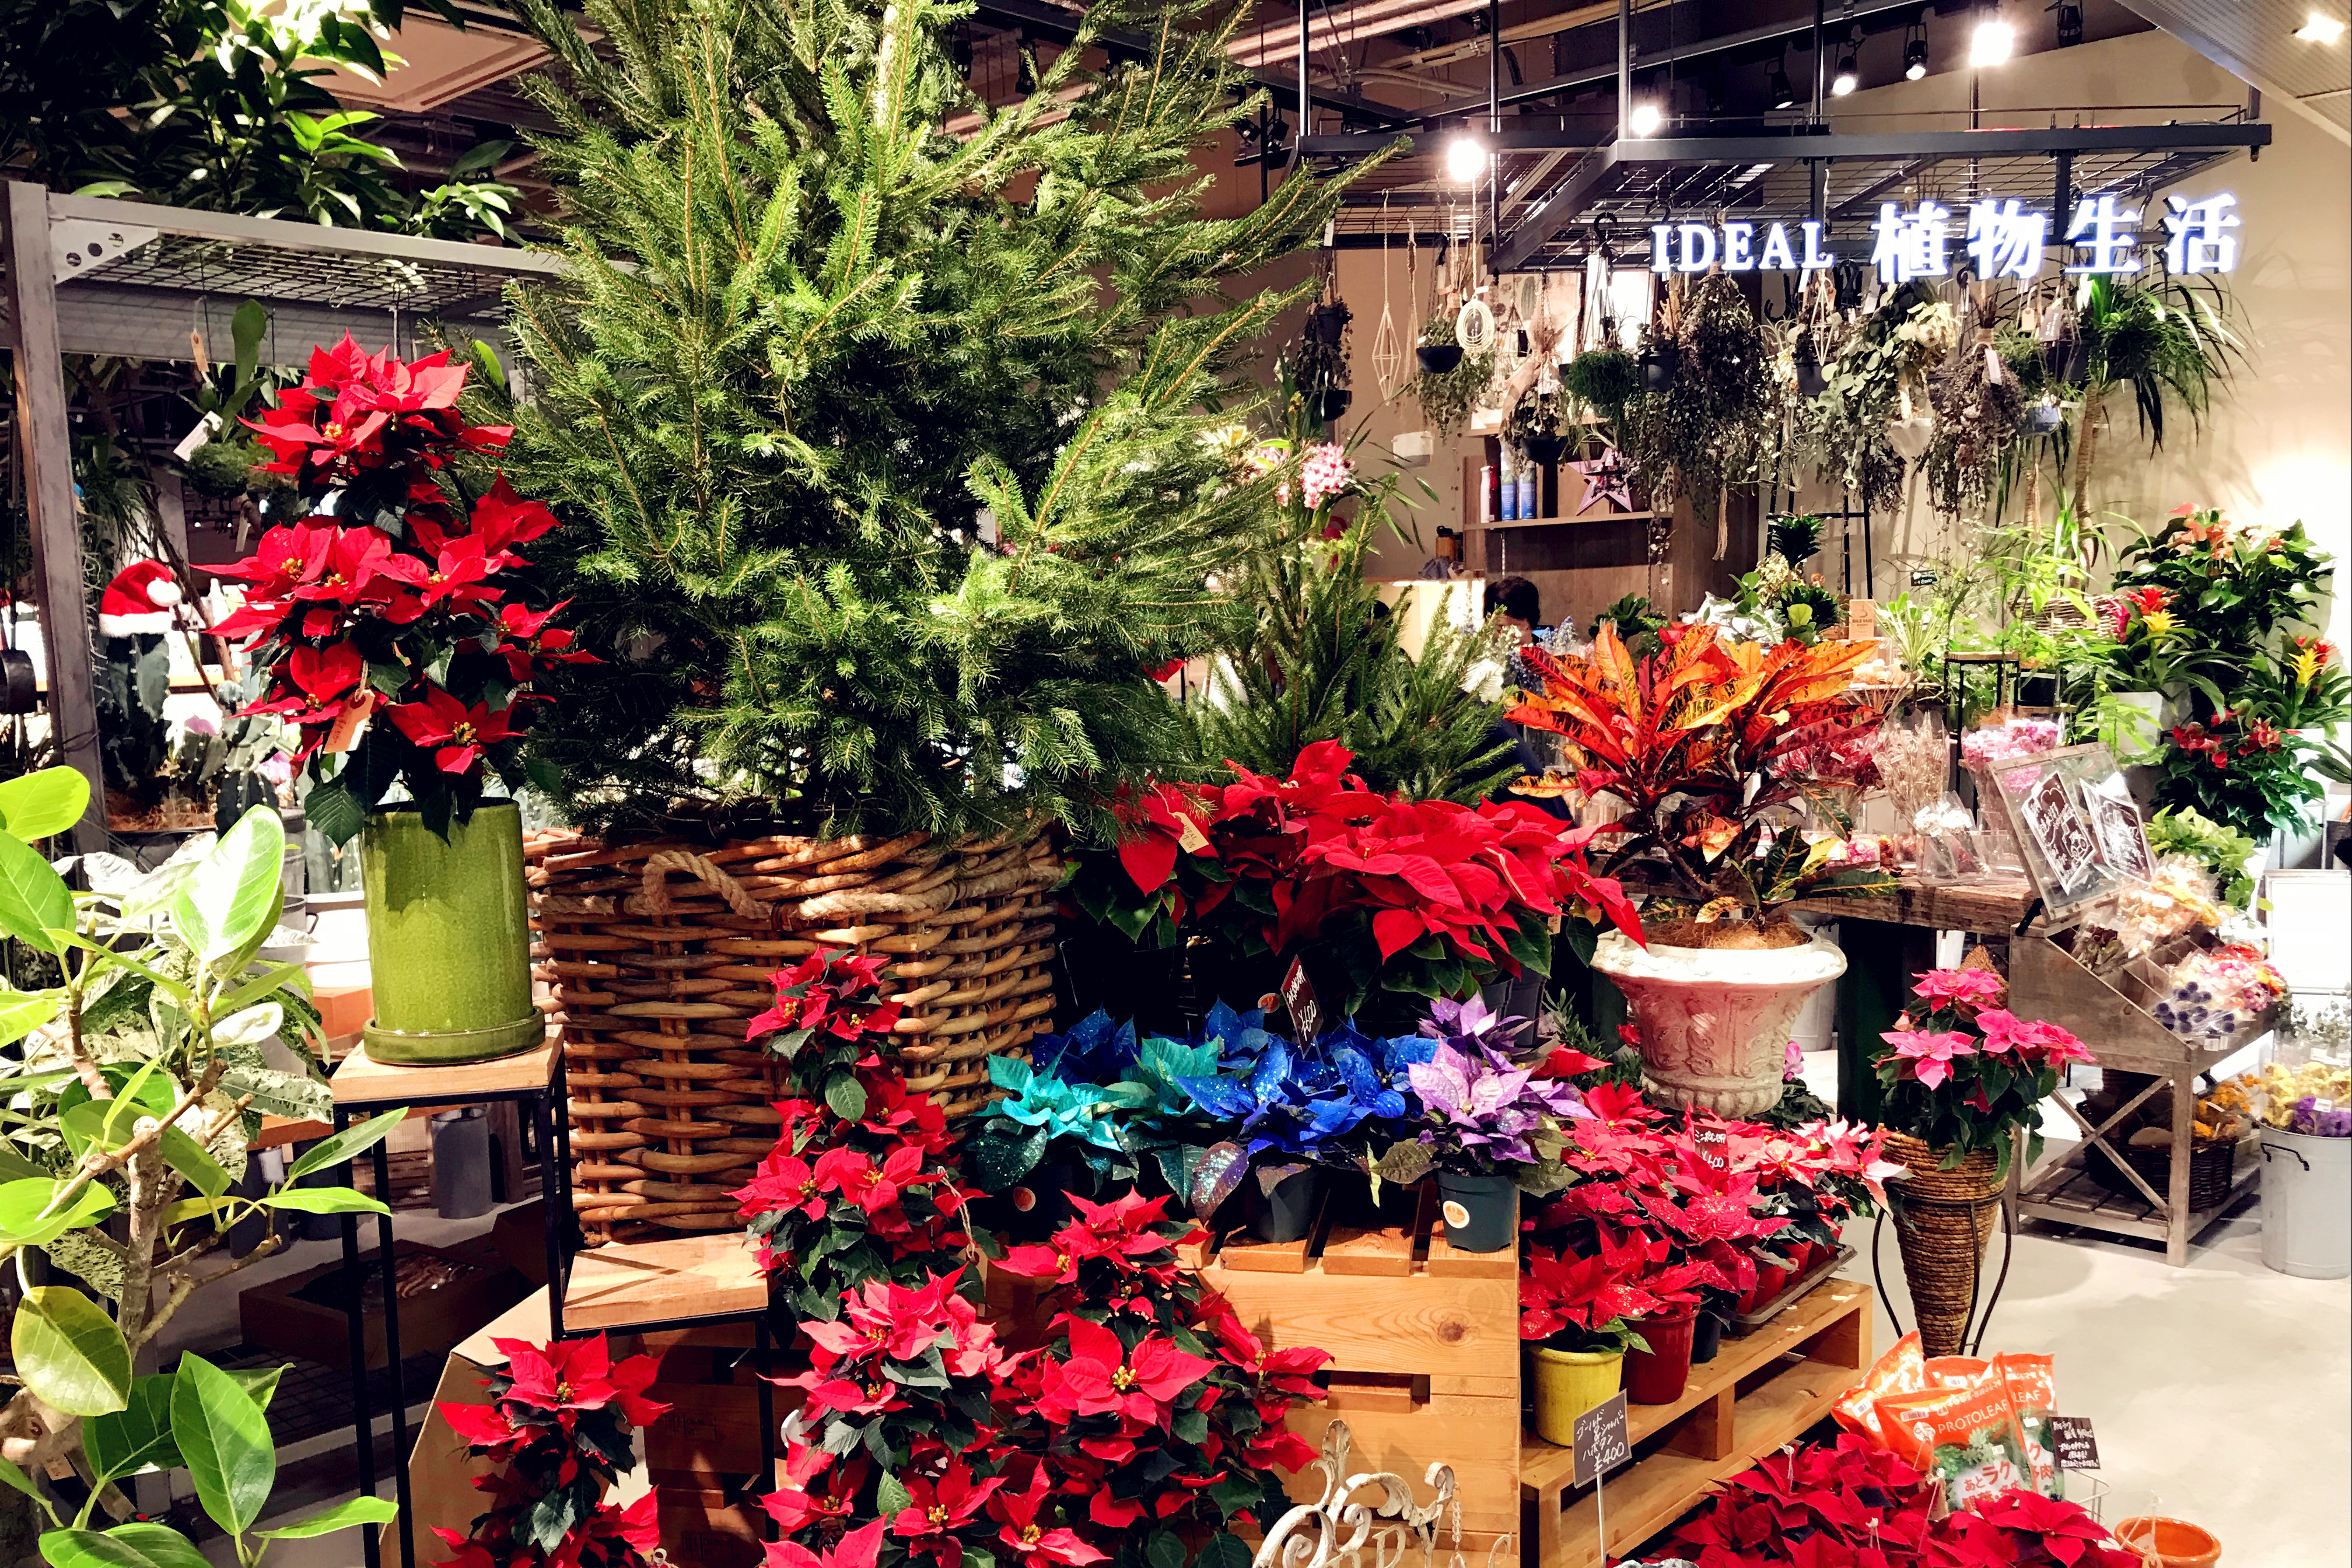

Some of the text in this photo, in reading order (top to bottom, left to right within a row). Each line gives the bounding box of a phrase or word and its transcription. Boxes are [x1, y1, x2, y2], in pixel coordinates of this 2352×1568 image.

[1650, 221, 1836, 273] IDEAL
[1870, 192, 2241, 284] 植物生活
[1937, 1398, 2008, 1434] PROTOLEAF
[1594, 1441, 1625, 1472] ¥400
